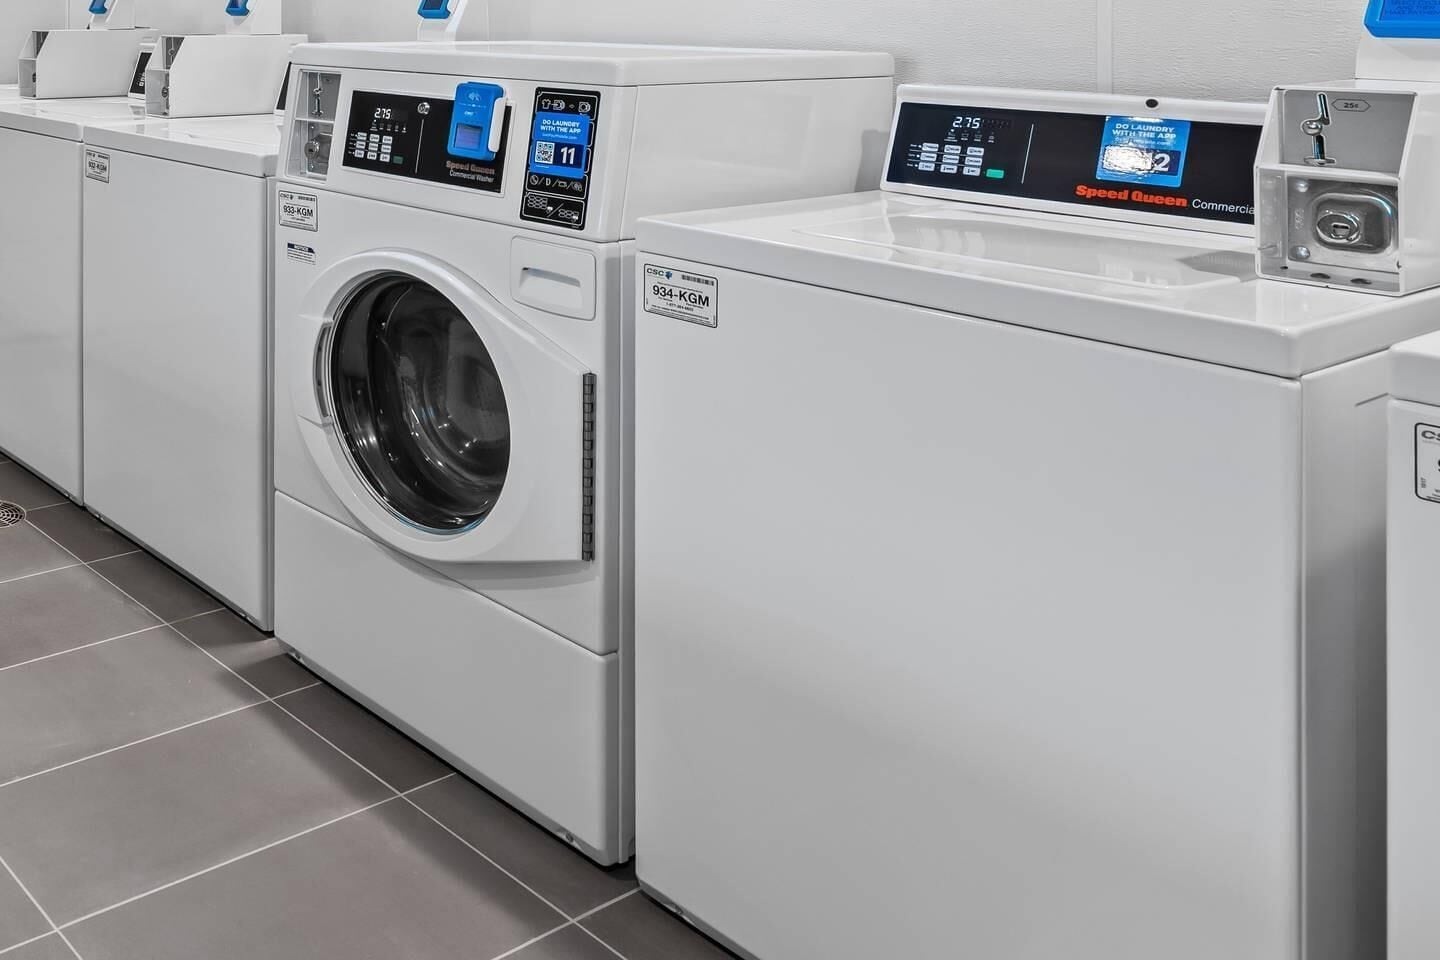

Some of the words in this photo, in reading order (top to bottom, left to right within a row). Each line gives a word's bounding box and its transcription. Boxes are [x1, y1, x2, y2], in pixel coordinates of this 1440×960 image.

[552, 120, 580, 128] LAUNDRY
[1131, 125, 1175, 133] LAUNDRY
[1112, 129, 1136, 137] WITH
[1137, 131, 1155, 139] THE
[560, 146, 576, 165] 11
[446, 161, 470, 170] Speed
[470, 164, 495, 175] Queen
[450, 170, 476, 180] Commercial
[1075, 185, 1129, 199] Speed
[1131, 191, 1188, 207] Queen
[283, 205, 314, 217] 933-KGM
[646, 268, 664, 276] CSC
[652, 285, 709, 307] 934-KGM
